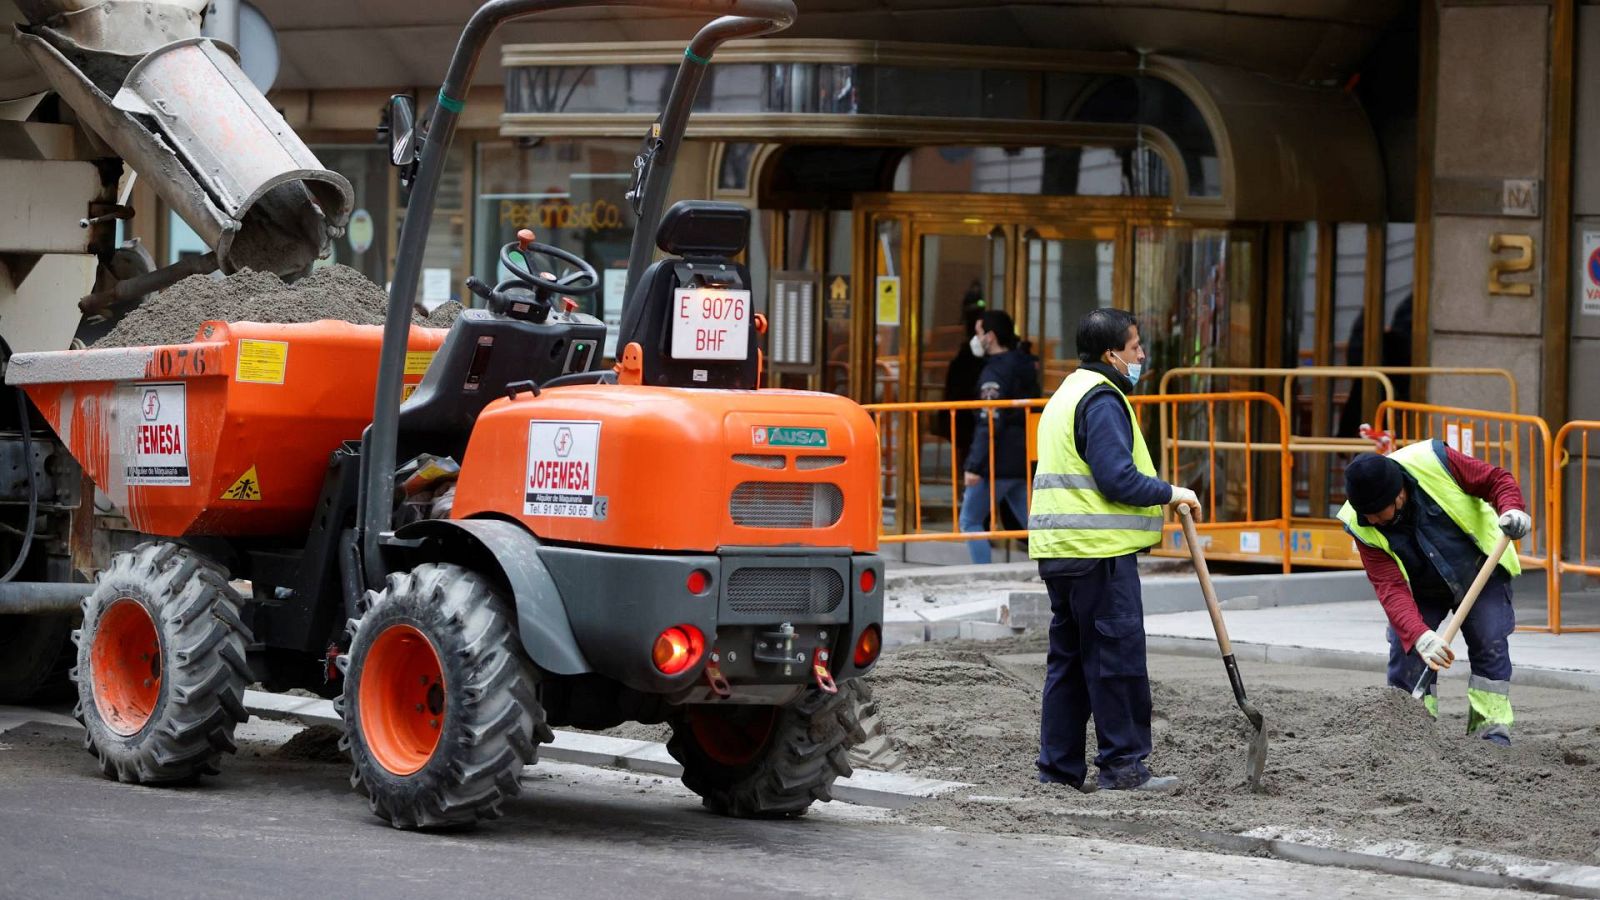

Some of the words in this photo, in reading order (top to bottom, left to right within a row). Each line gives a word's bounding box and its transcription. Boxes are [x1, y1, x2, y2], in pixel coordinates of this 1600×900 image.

[1489, 234, 1533, 297] 2
[680, 296, 691, 319] E
[702, 297, 744, 321] 9076
[695, 329, 728, 352] BHF
[144, 348, 206, 379] 076
[530, 460, 590, 490] JOFEMESA
[530, 503, 541, 515] Tel.
[543, 504, 552, 515] 91
[553, 505, 567, 515] 907
[568, 506, 577, 516] 50
[578, 506, 588, 516] 65
